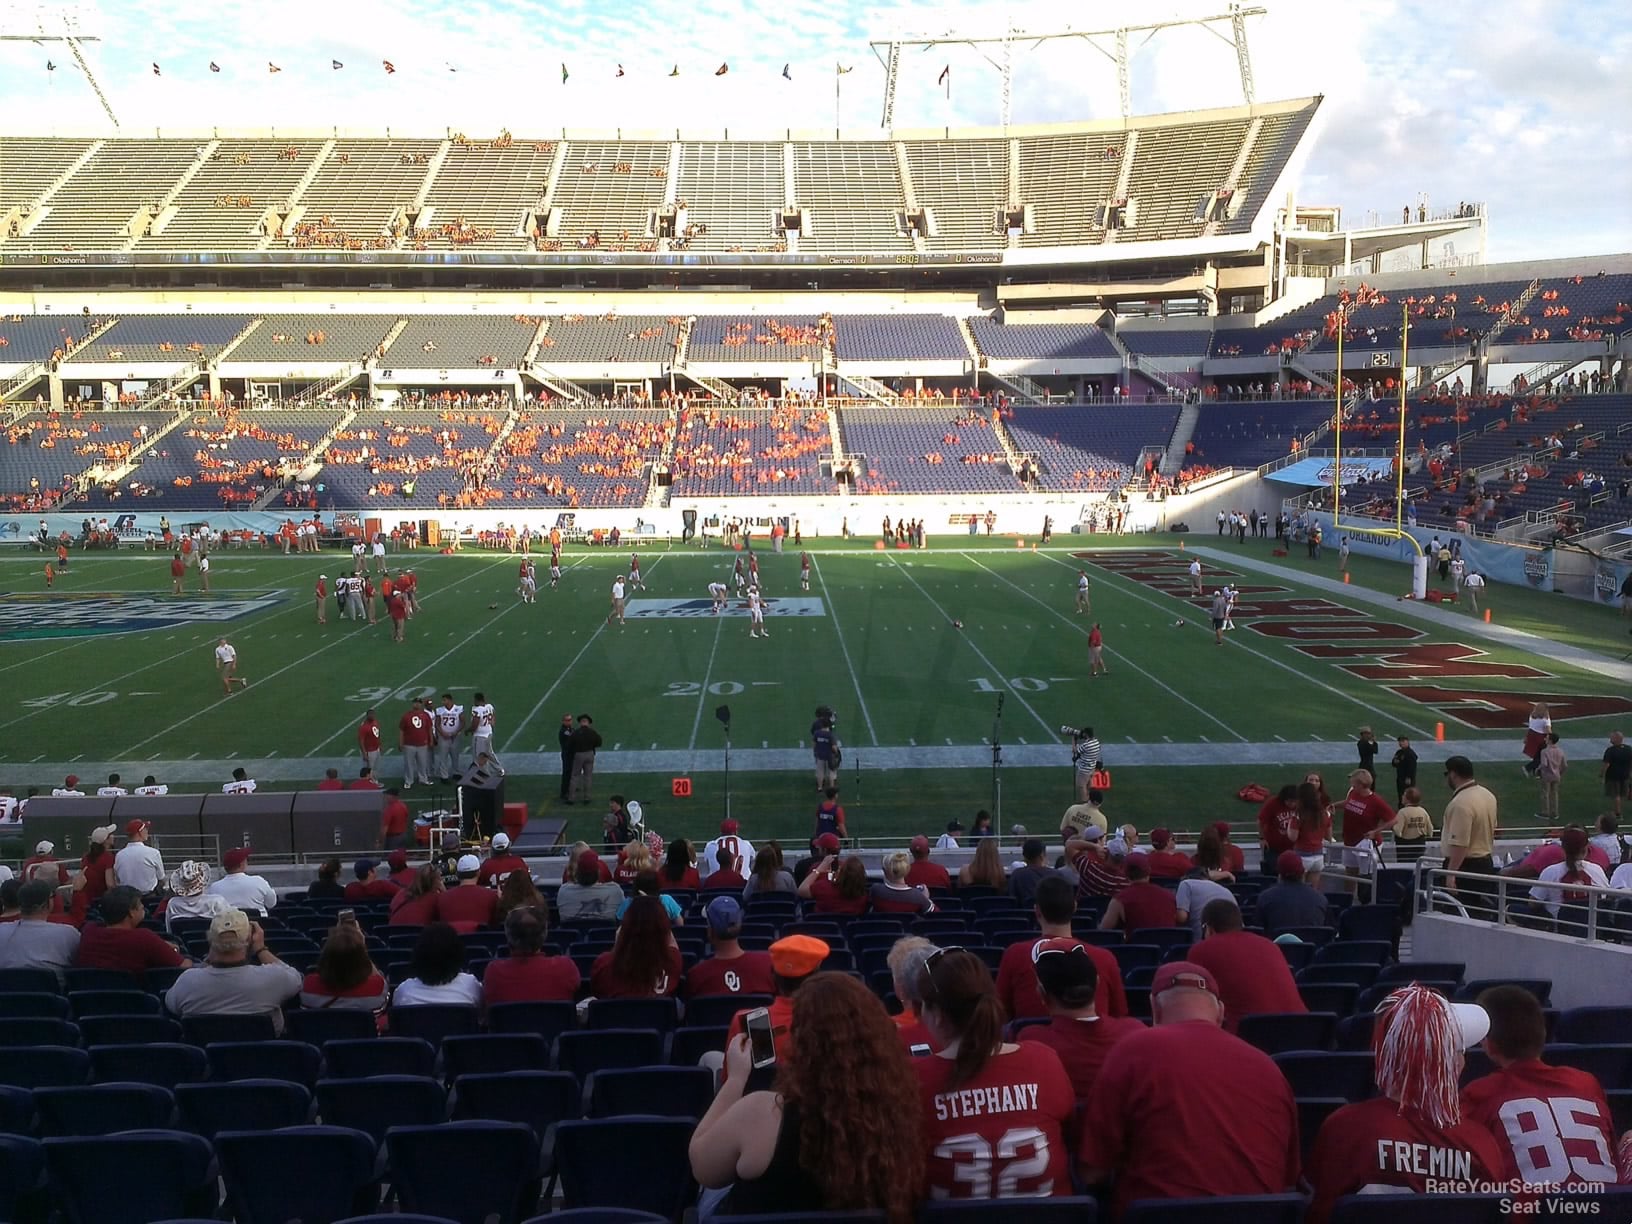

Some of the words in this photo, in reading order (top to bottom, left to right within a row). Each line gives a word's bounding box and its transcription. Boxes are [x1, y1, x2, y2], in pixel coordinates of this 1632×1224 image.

[53, 256, 86, 264] Oklahoma
[1373, 353, 1388, 366] 25
[1349, 532, 1391, 547] ORLANDO
[350, 582, 361, 590] 85
[662, 681, 745, 697] 20
[968, 677, 1050, 692] 10
[343, 686, 437, 702] 30
[443, 717, 456, 727] 73
[674, 780, 689, 794] 20
[1095, 773, 1108, 787] 10
[724, 970, 741, 992] OU
[934, 1083, 1038, 1121] STEPHANY
[1498, 1096, 1619, 1185] 85
[930, 1126, 1055, 1200] 32
[1377, 1139, 1472, 1182] FREMIN
